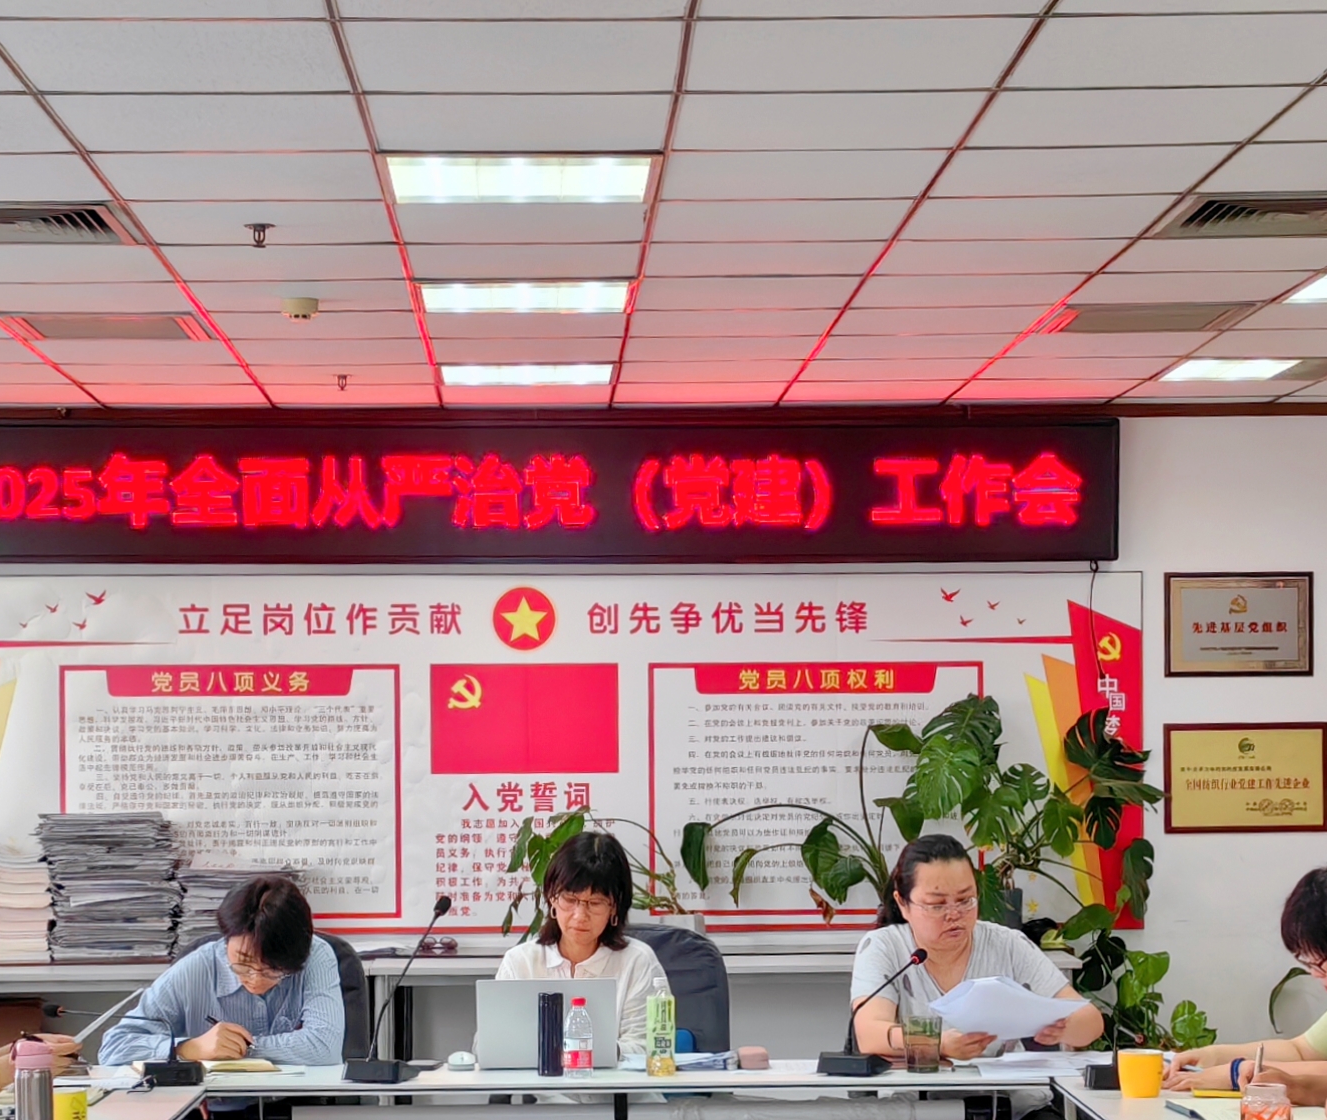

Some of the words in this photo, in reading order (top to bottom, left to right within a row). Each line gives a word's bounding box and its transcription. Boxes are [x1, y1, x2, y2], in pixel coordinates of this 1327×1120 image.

[178, 602, 463, 635] 立足岗位作贡献
[587, 601, 868, 634] 创先争优当先锋
[151, 671, 310, 692] 党员八项义务
[738, 669, 895, 691] 党员八项权利
[462, 781, 591, 812] 入党誓词
